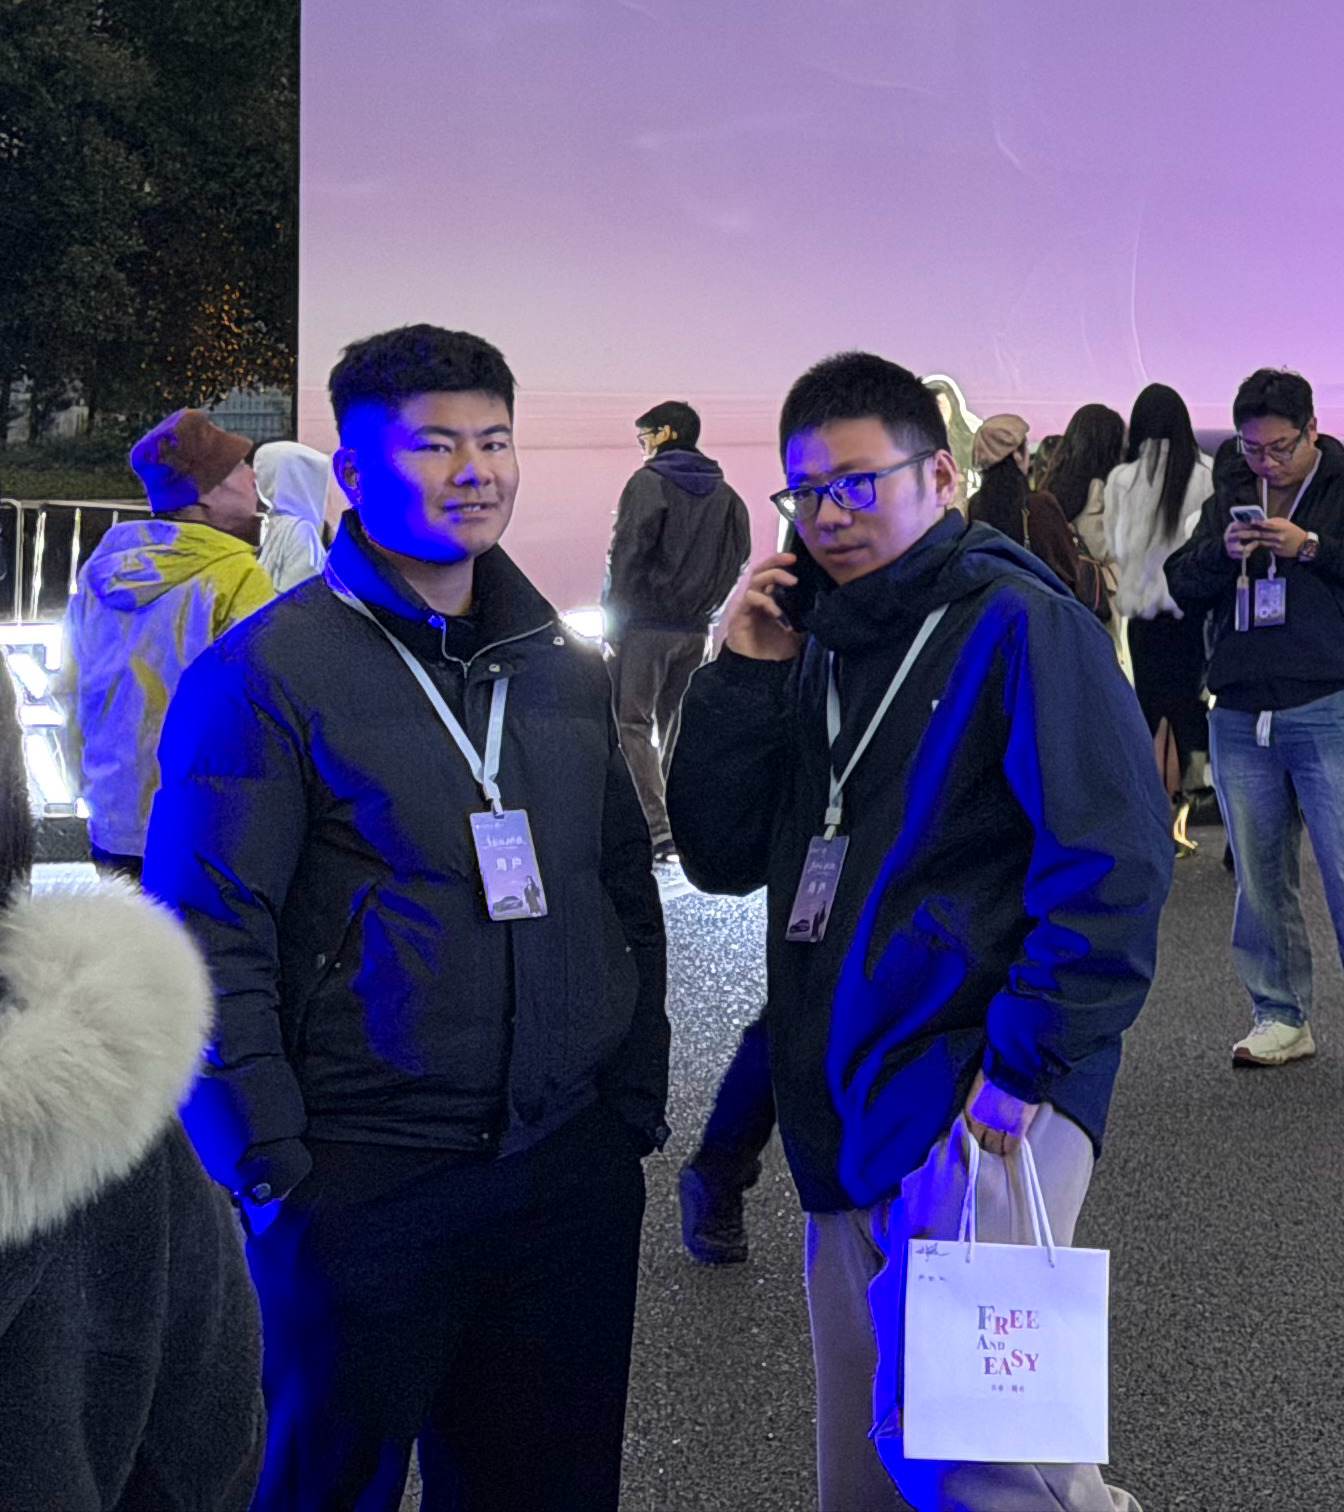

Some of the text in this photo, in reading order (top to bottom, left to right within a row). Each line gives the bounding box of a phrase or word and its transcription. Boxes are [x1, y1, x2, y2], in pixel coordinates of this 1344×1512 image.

[977, 1304, 1040, 1335] FREE
[977, 1334, 1005, 1350] AND
[984, 1348, 1039, 1376] EASY
